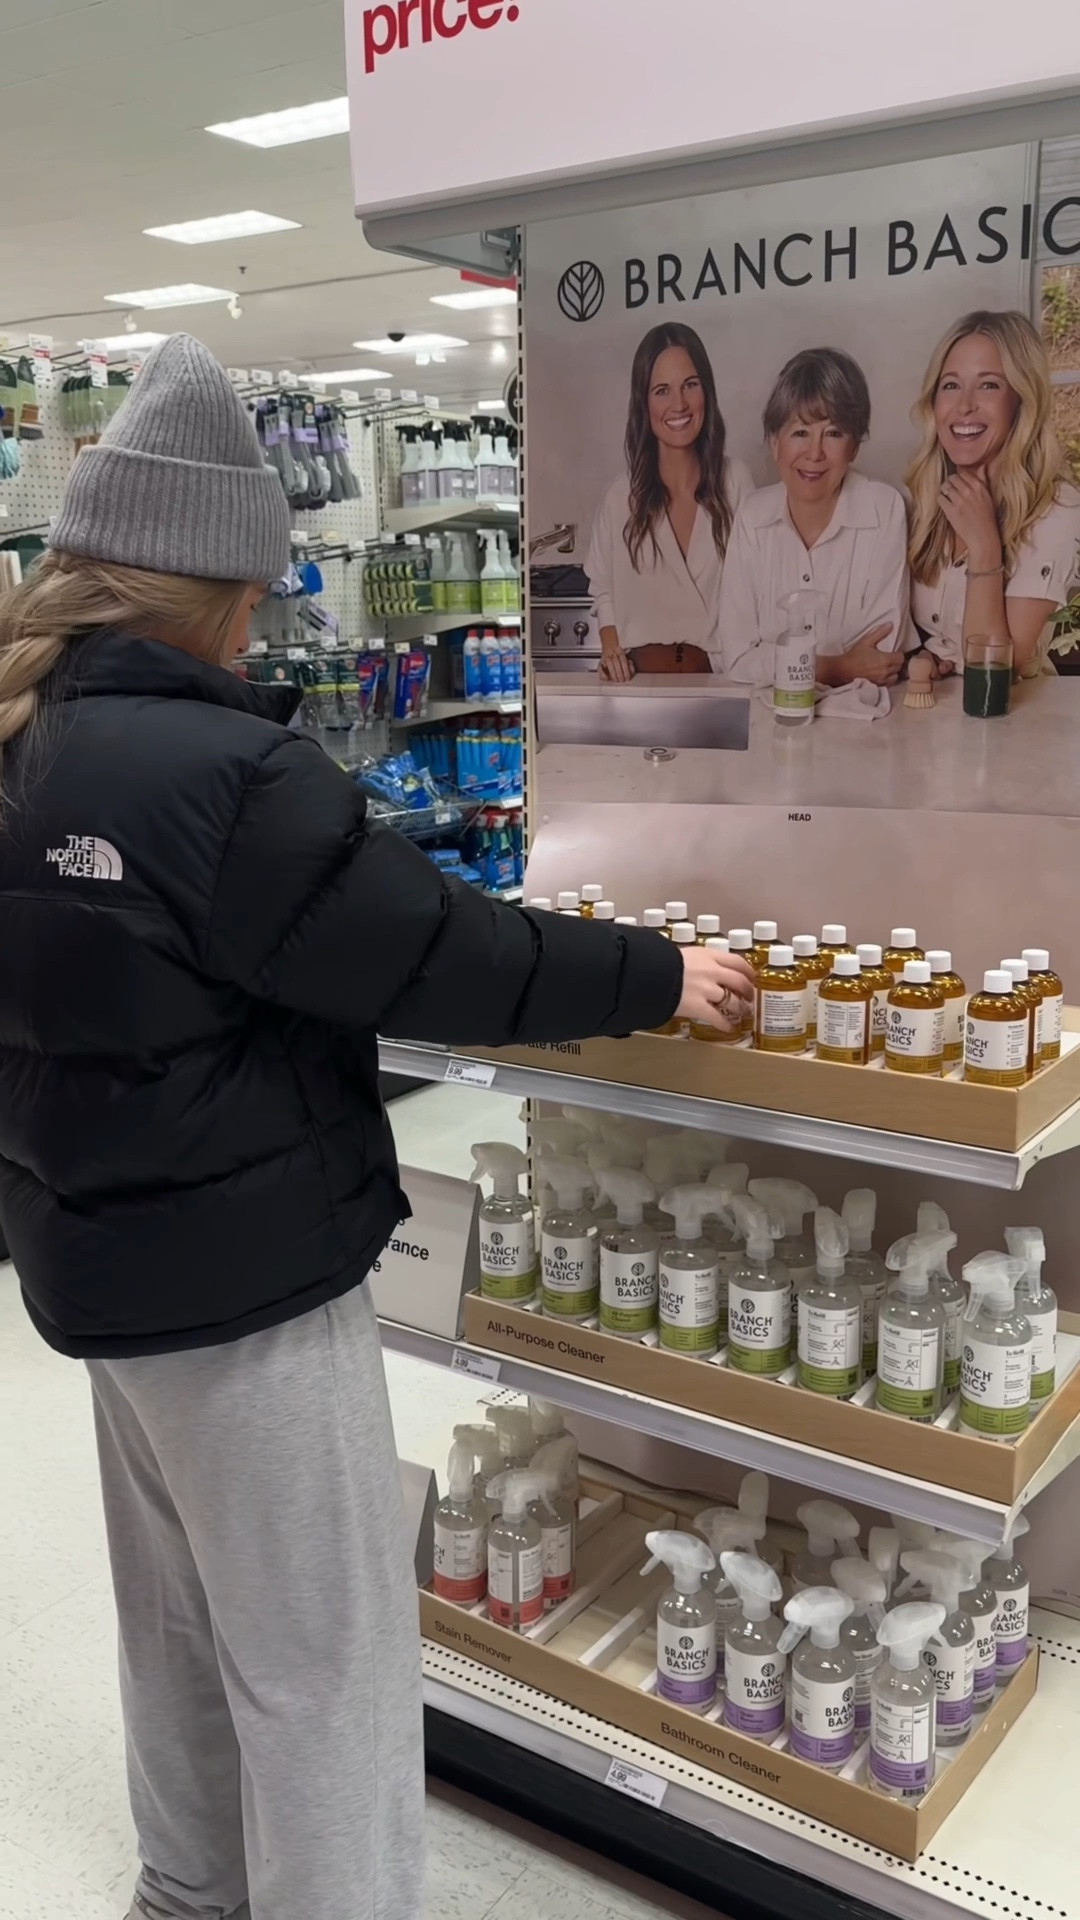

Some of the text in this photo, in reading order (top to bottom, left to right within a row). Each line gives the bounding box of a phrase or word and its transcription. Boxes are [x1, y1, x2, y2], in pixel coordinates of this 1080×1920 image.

[625, 226, 857, 309] BRANCH
[788, 813, 812, 822] HEAD
[66, 835, 94, 850] THE
[46, 848, 93, 863] NORTH
[58, 862, 93, 877] FACE
[550, 1042, 581, 1055] Refill
[730, 1308, 772, 1326] BRANCH
[730, 1321, 769, 1337] BASICS
[487, 1320, 606, 1364] All-Purpose Cleaner
[435, 1620, 512, 1663] Stain Remover
[664, 1646, 709, 1661] BRANCH
[667, 1658, 707, 1670] BASICS
[661, 1722, 782, 1784] Bathroom Cleaner
[610, 1770, 627, 1782] 4.99
